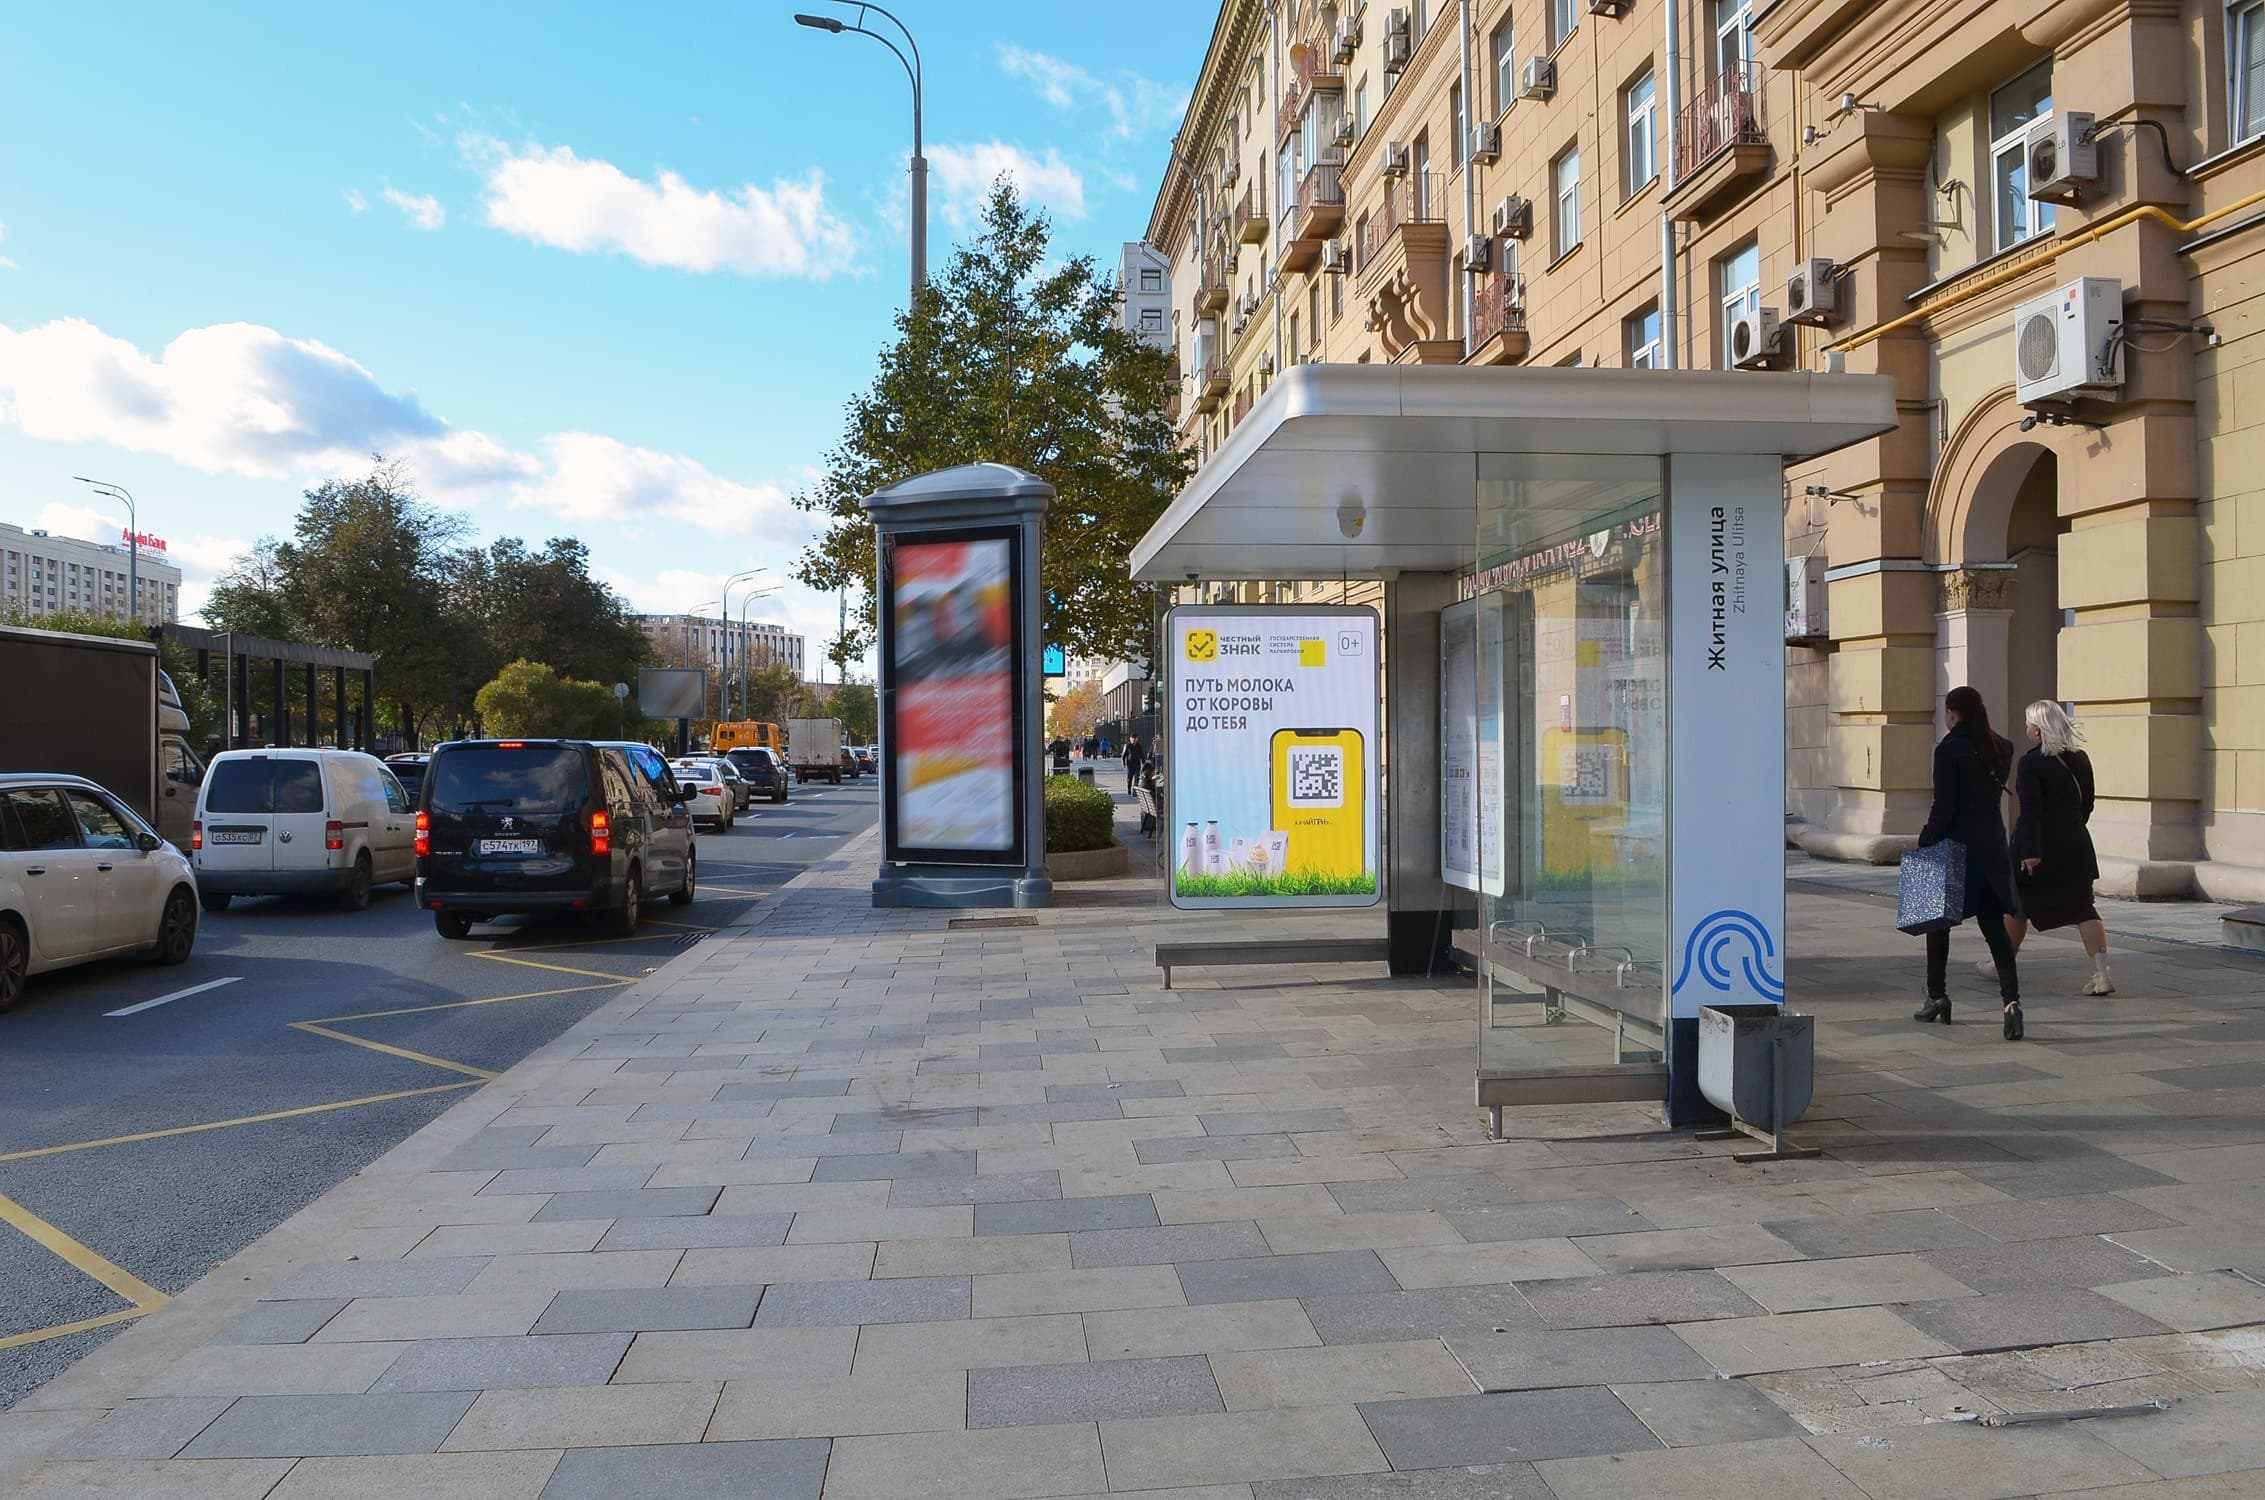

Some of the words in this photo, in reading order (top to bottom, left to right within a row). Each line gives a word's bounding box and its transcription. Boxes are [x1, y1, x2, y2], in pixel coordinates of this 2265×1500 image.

[1732, 506, 1744, 547] Ulitsa
[1711, 506, 1728, 574] улица
[1733, 551, 1747, 614] Zhitnaya
[1707, 581, 1726, 672] Житная
[1220, 635, 1261, 643] ЧЕСТНЫЙ
[1341, 636, 1360, 650] 0+
[1220, 644, 1261, 655] ЗНАК
[1185, 678, 1223, 693] ПУТЬ
[1227, 678, 1295, 693] МОЛОКА
[1186, 697, 1206, 711] ОТ
[1209, 697, 1273, 711] КОРОВЫ
[1186, 716, 1208, 732] ДО
[1212, 716, 1247, 730] ТЕБЯ
